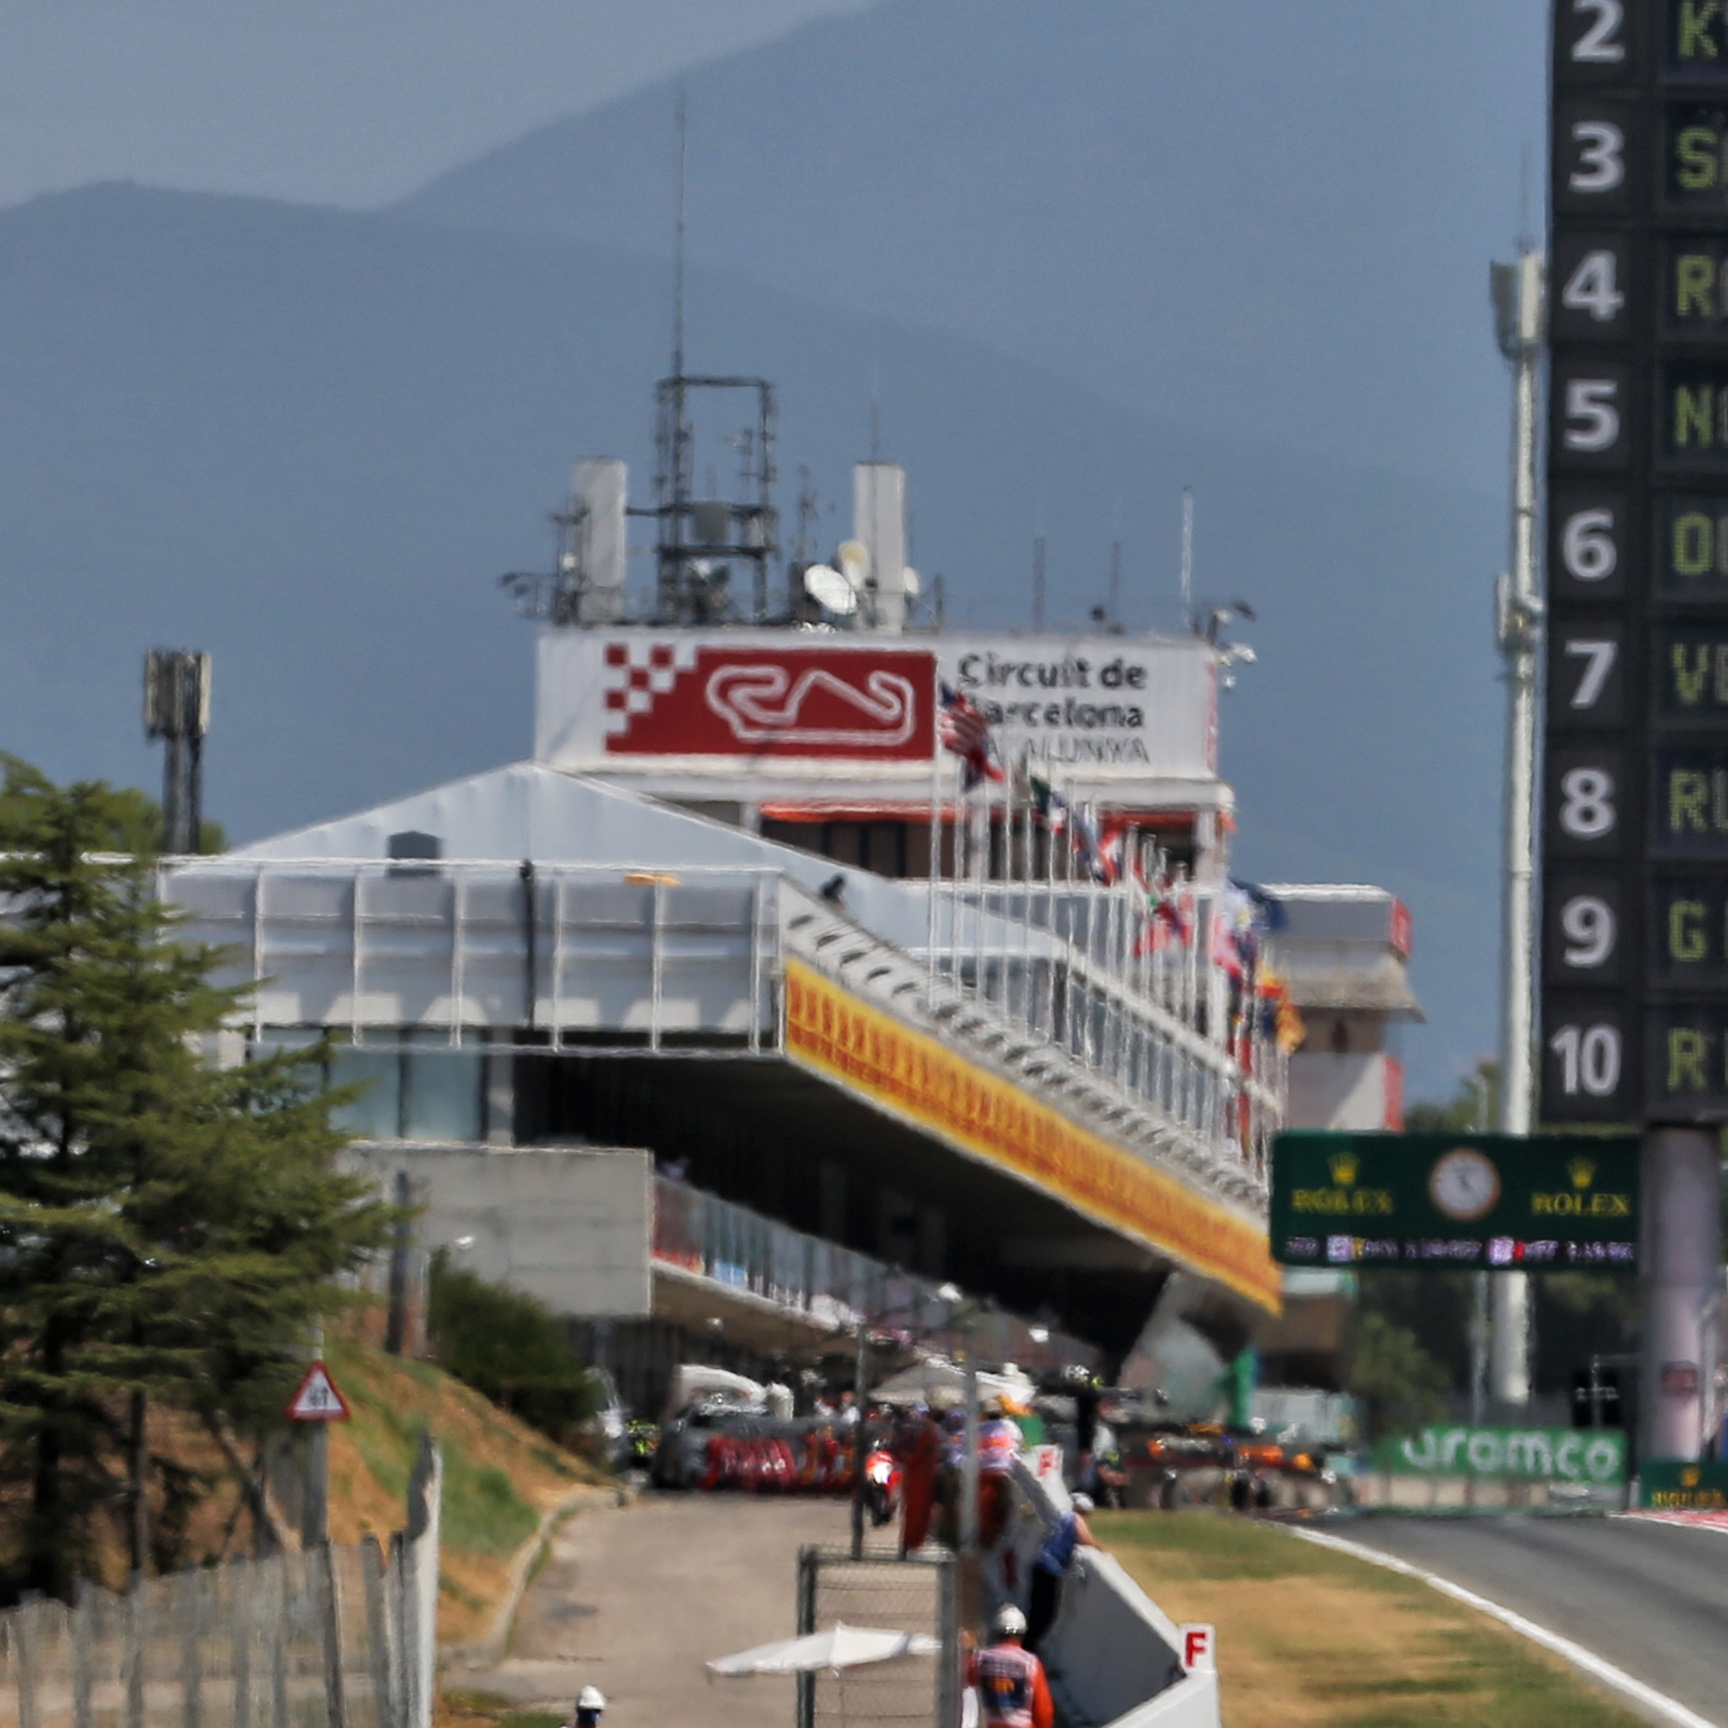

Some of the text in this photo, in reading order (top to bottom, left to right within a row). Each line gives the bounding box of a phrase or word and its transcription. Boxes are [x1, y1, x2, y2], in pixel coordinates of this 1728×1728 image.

[1571, 0, 1626, 62] 2
[1569, 120, 1626, 193] 3
[1561, 249, 1625, 322] 4
[1564, 378, 1621, 453] 5
[1561, 508, 1618, 581] 6
[958, 651, 1146, 690] Circuit de
[1563, 640, 1618, 711] 7
[1560, 767, 1617, 839] 8
[1561, 895, 1616, 969] 9
[1550, 1023, 1621, 1098] 10
[1531, 1191, 1633, 1218] ROLEX
[1184, 1631, 1208, 1668] F
